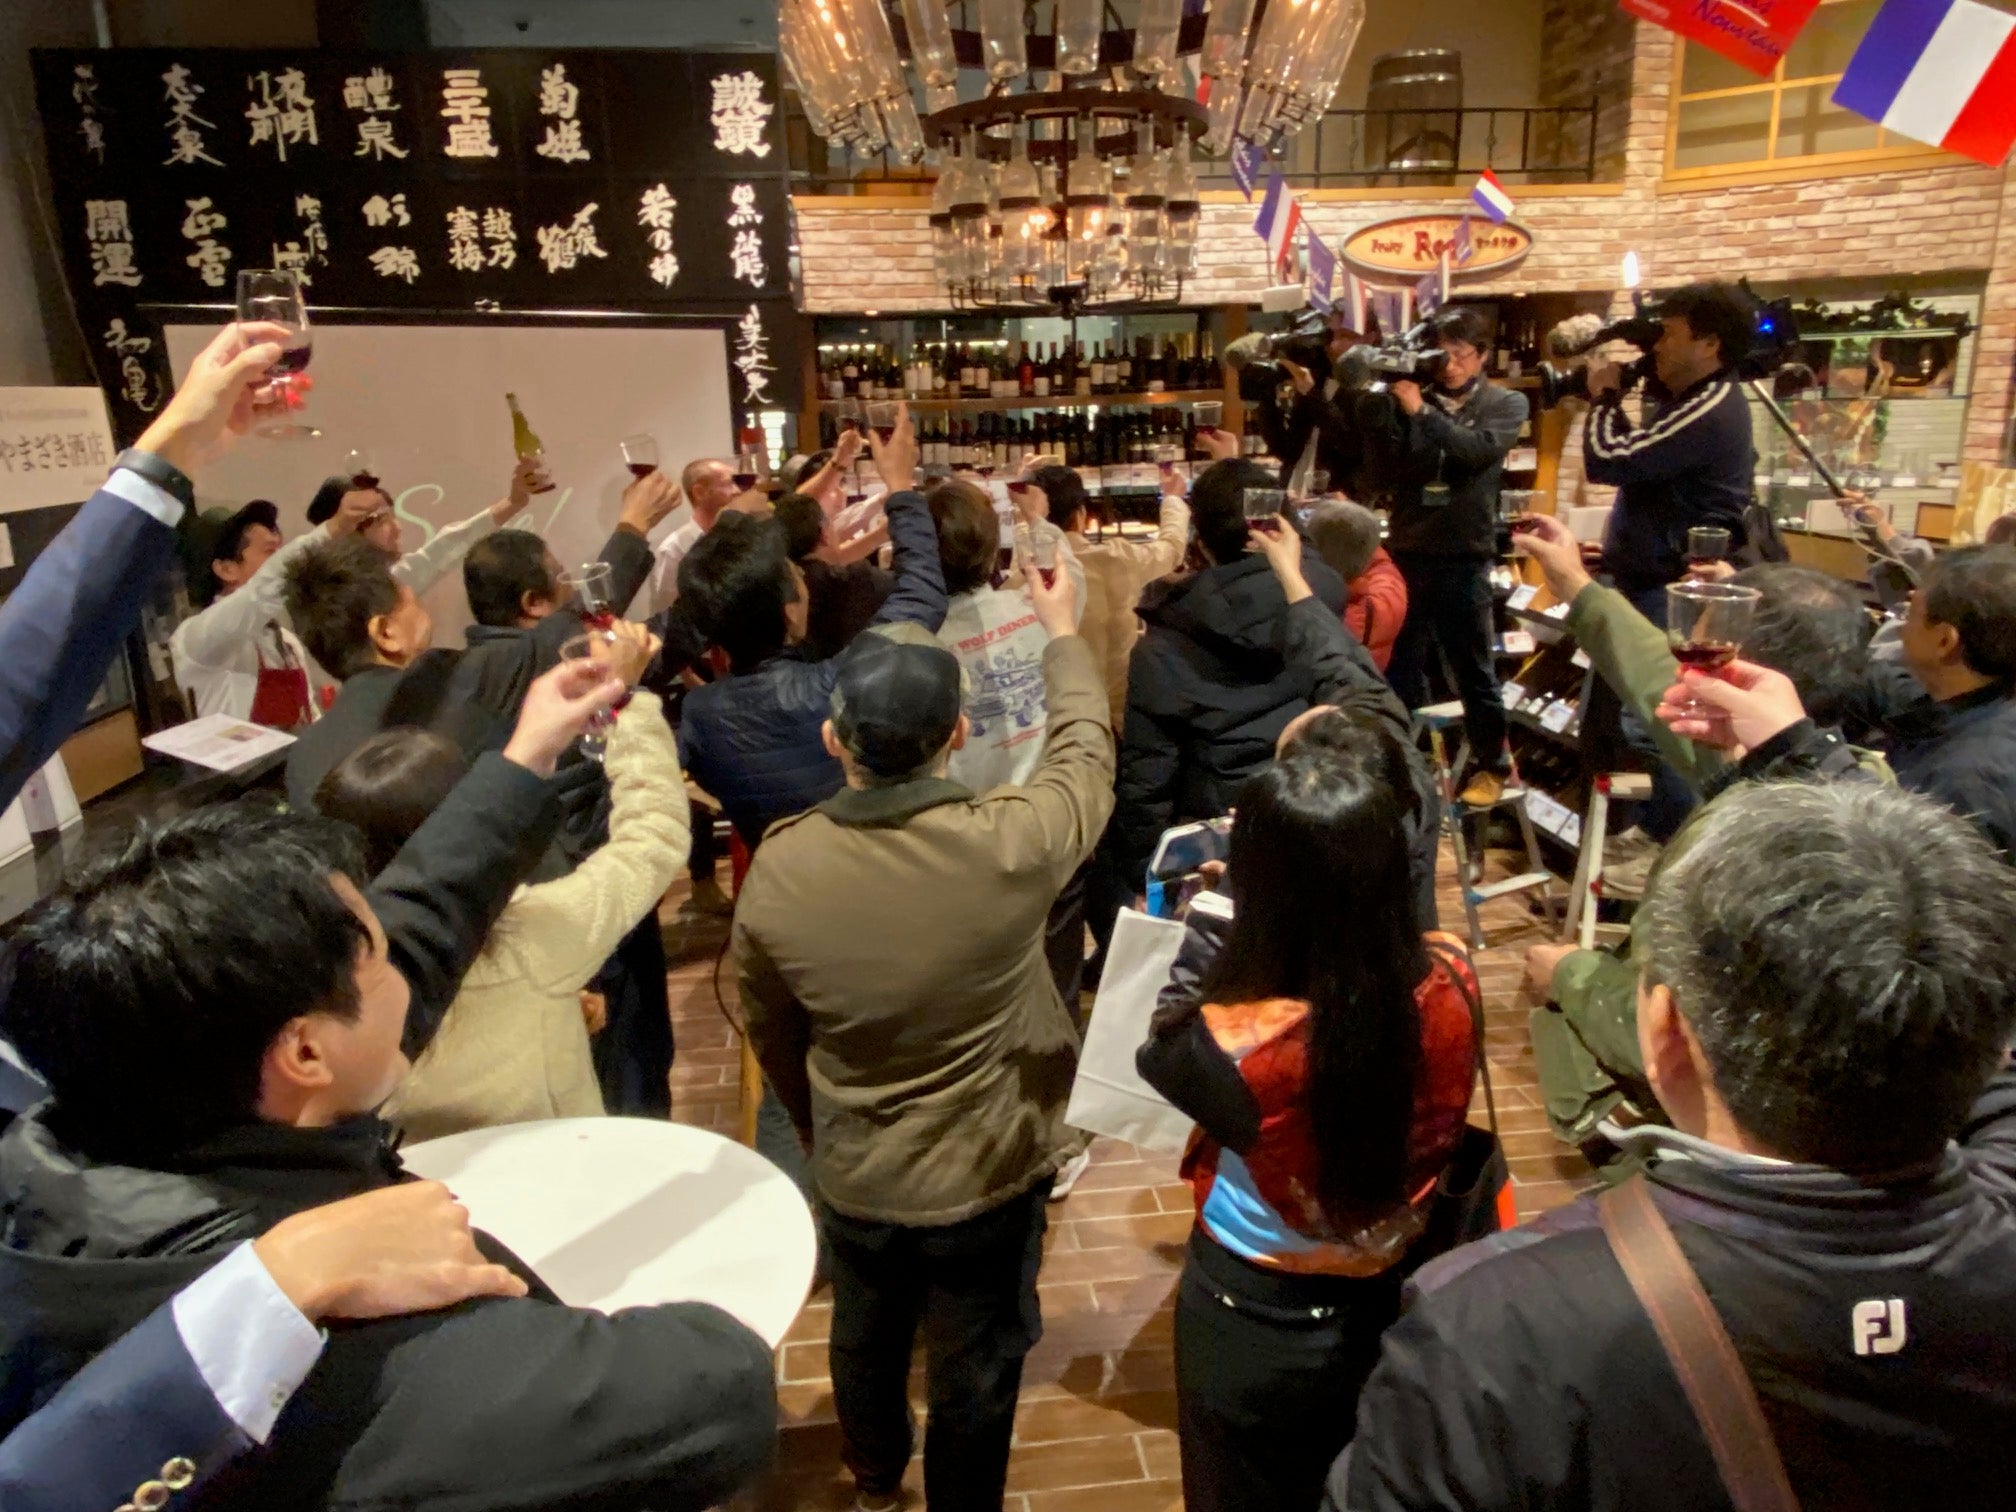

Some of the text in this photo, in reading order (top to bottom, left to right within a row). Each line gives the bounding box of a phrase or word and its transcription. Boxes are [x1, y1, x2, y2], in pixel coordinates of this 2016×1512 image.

[440, 69, 499, 158] 三千盛
[536, 63, 591, 164] 菊姫
[727, 184, 765, 288] 黒龍
[733, 303, 777, 404] 美丈夫
[1853, 1299, 1905, 1355] FJ
